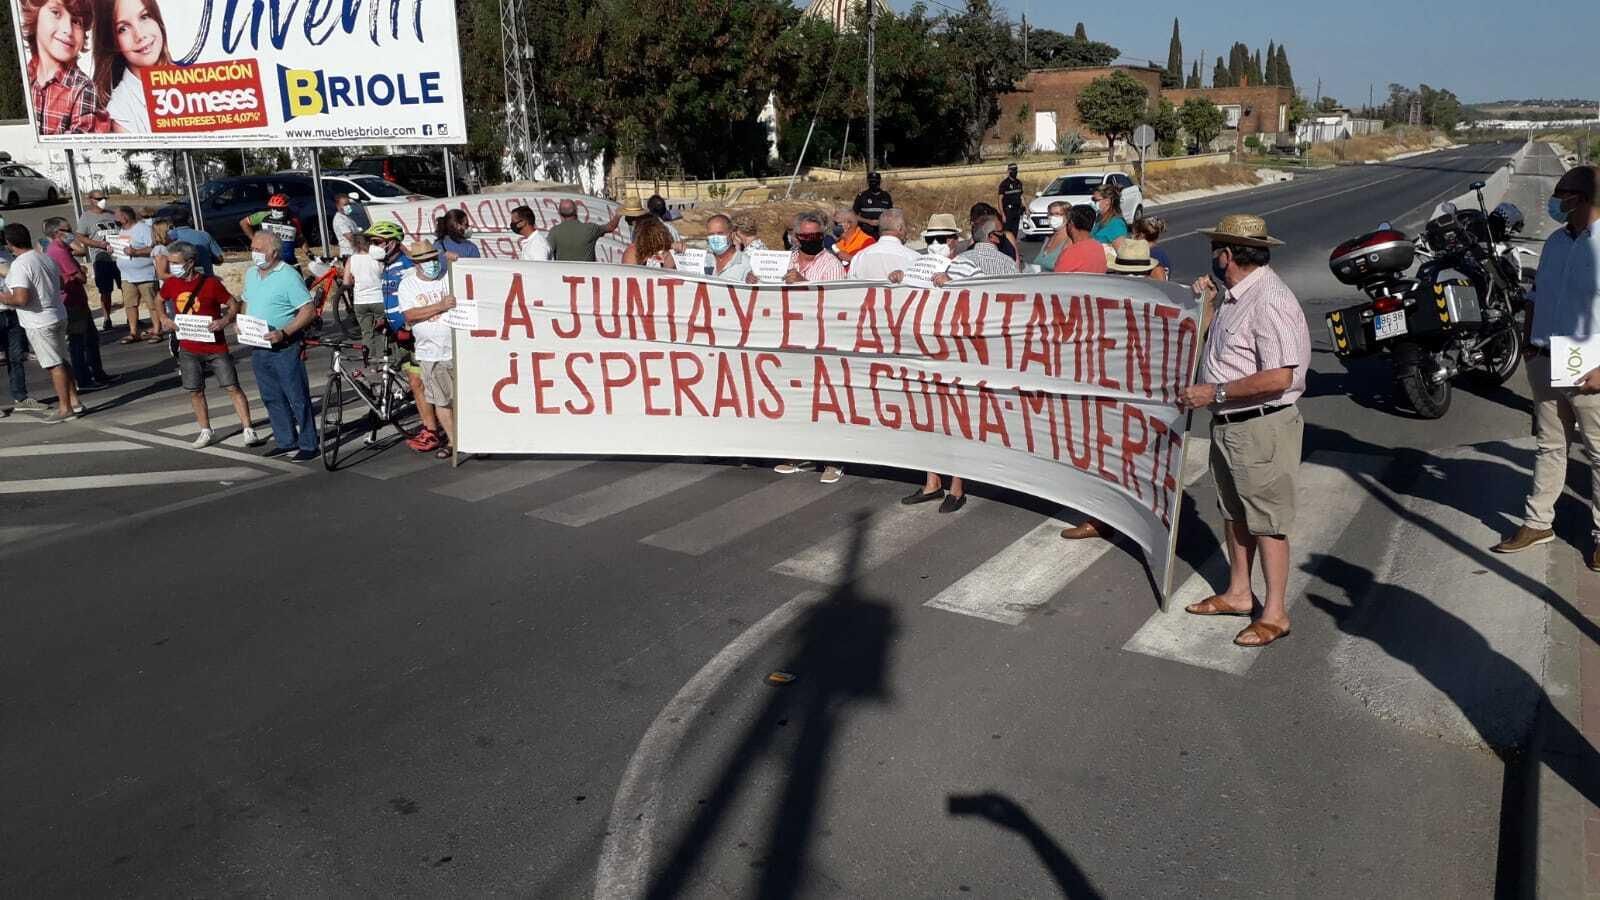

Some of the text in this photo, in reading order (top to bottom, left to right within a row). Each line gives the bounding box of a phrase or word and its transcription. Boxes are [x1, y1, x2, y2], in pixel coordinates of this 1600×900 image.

[150, 61, 254, 86] FINANCIACIÓN
[151, 87, 258, 116] 30 meses
[285, 69, 444, 116] BRIOLE
[156, 118, 171, 128] SIN
[171, 115, 217, 127] INTERESES
[217, 113, 233, 124] TAE
[286, 126, 416, 138] www.mueblesbriole.com
[552, 276, 716, 347] JUNTA
[727, 284, 760, 348] Y
[780, 284, 837, 352] EL
[854, 286, 1197, 413] AYUNTAMIENTO
[1566, 347, 1583, 377] VOX
[811, 355, 1011, 448] ALGUNA
